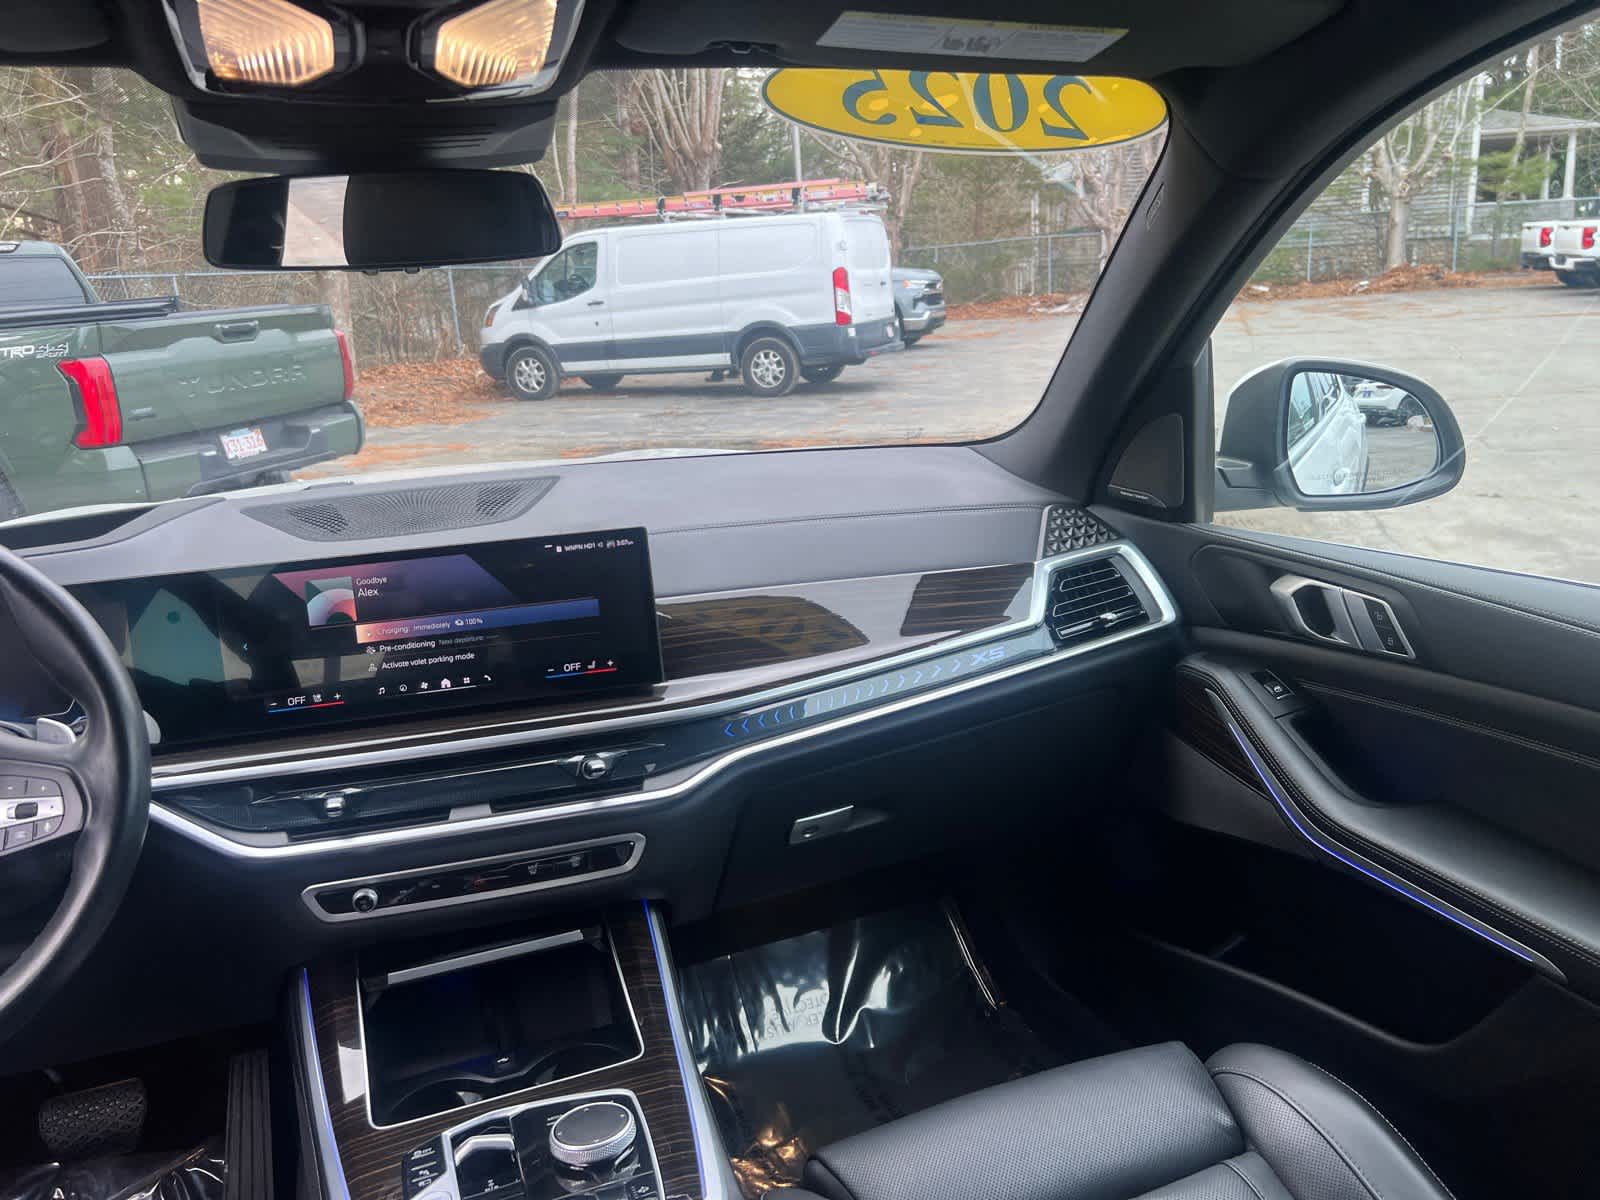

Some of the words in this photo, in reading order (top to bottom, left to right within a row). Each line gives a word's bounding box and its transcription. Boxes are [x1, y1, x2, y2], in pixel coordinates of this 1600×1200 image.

[356, 577, 387, 585] Goodbye
[358, 588, 380, 598] Alex
[413, 622, 451, 632] Immediately
[379, 640, 436, 653] Pre-conditioning
[381, 661, 409, 670] Activate
[410, 658, 427, 667] valet
[428, 654, 454, 665] parking
[455, 651, 475, 661] mode
[970, 645, 1006, 666] X5
[563, 662, 582, 672] OFF
[287, 695, 306, 706] OFF
